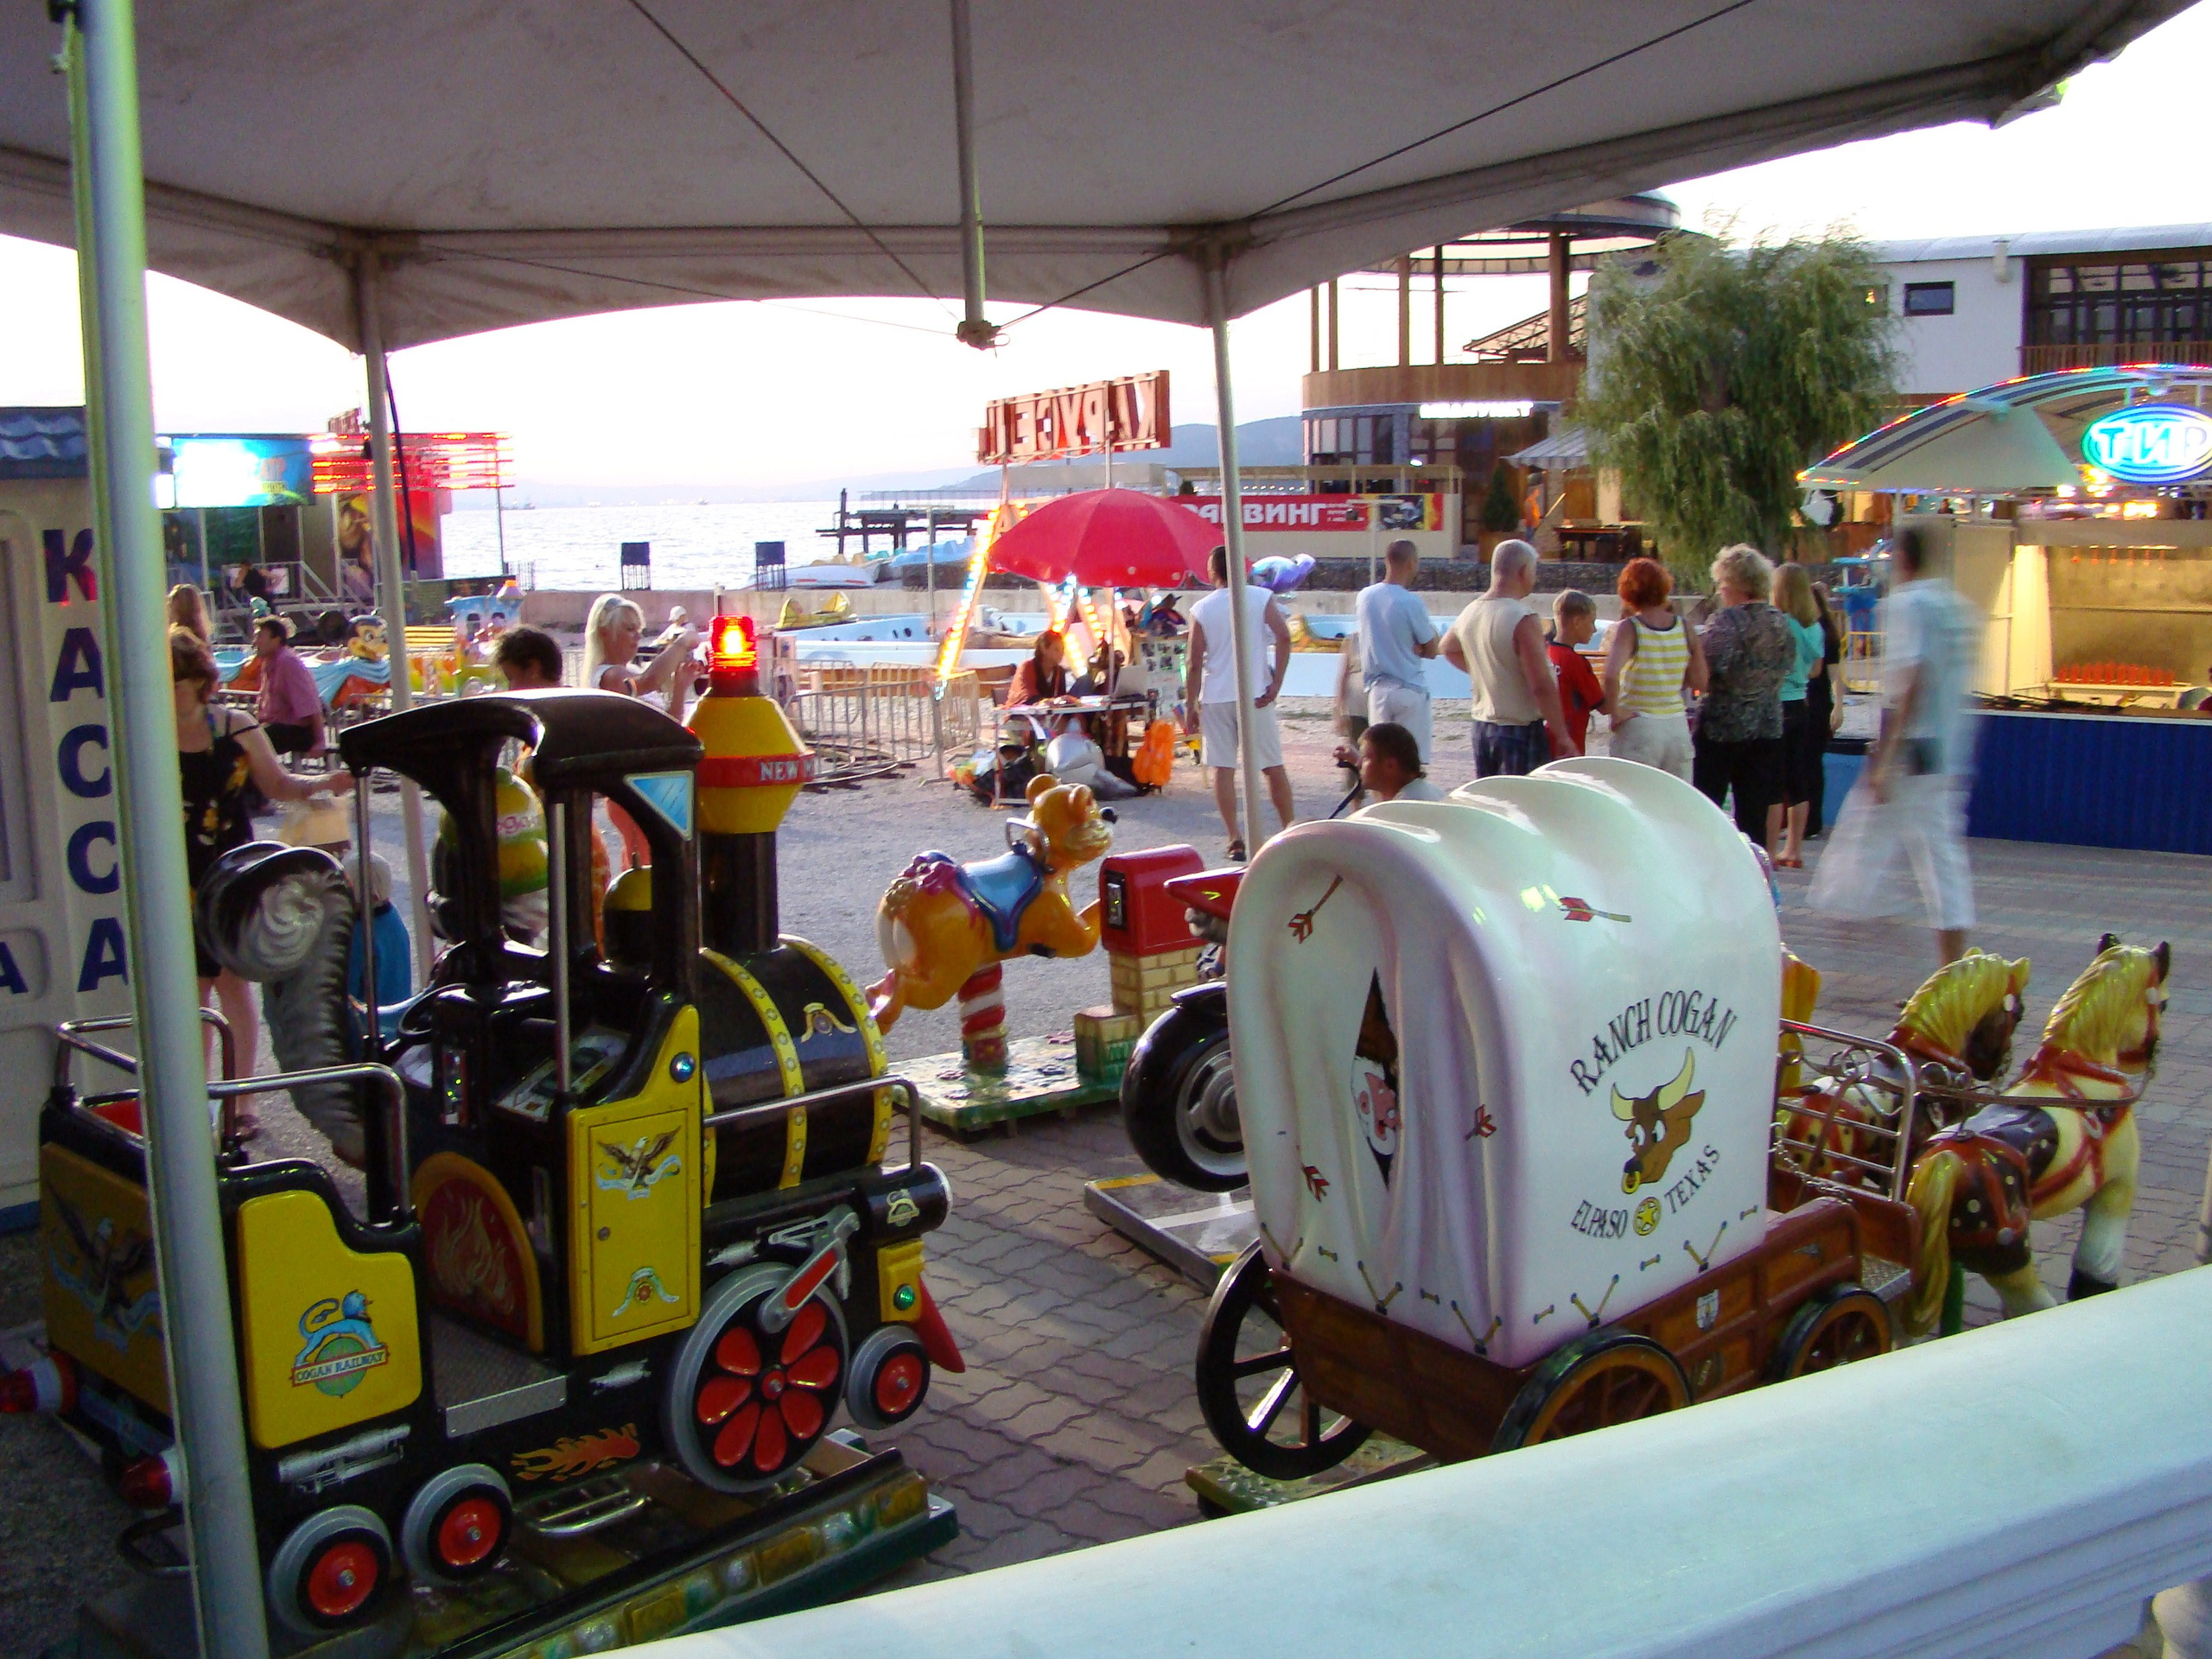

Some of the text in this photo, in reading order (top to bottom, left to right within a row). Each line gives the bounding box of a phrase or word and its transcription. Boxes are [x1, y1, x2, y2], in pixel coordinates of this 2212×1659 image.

[2089, 422, 2209, 465] ТИР
[43, 528, 128, 992] КАССА
[760, 760, 799, 781] NEW
[1569, 989, 1738, 1096] RANCH COGAN
[1663, 1144, 1721, 1215] TEXAS
[335, 1351, 385, 1372] RAILWAY
